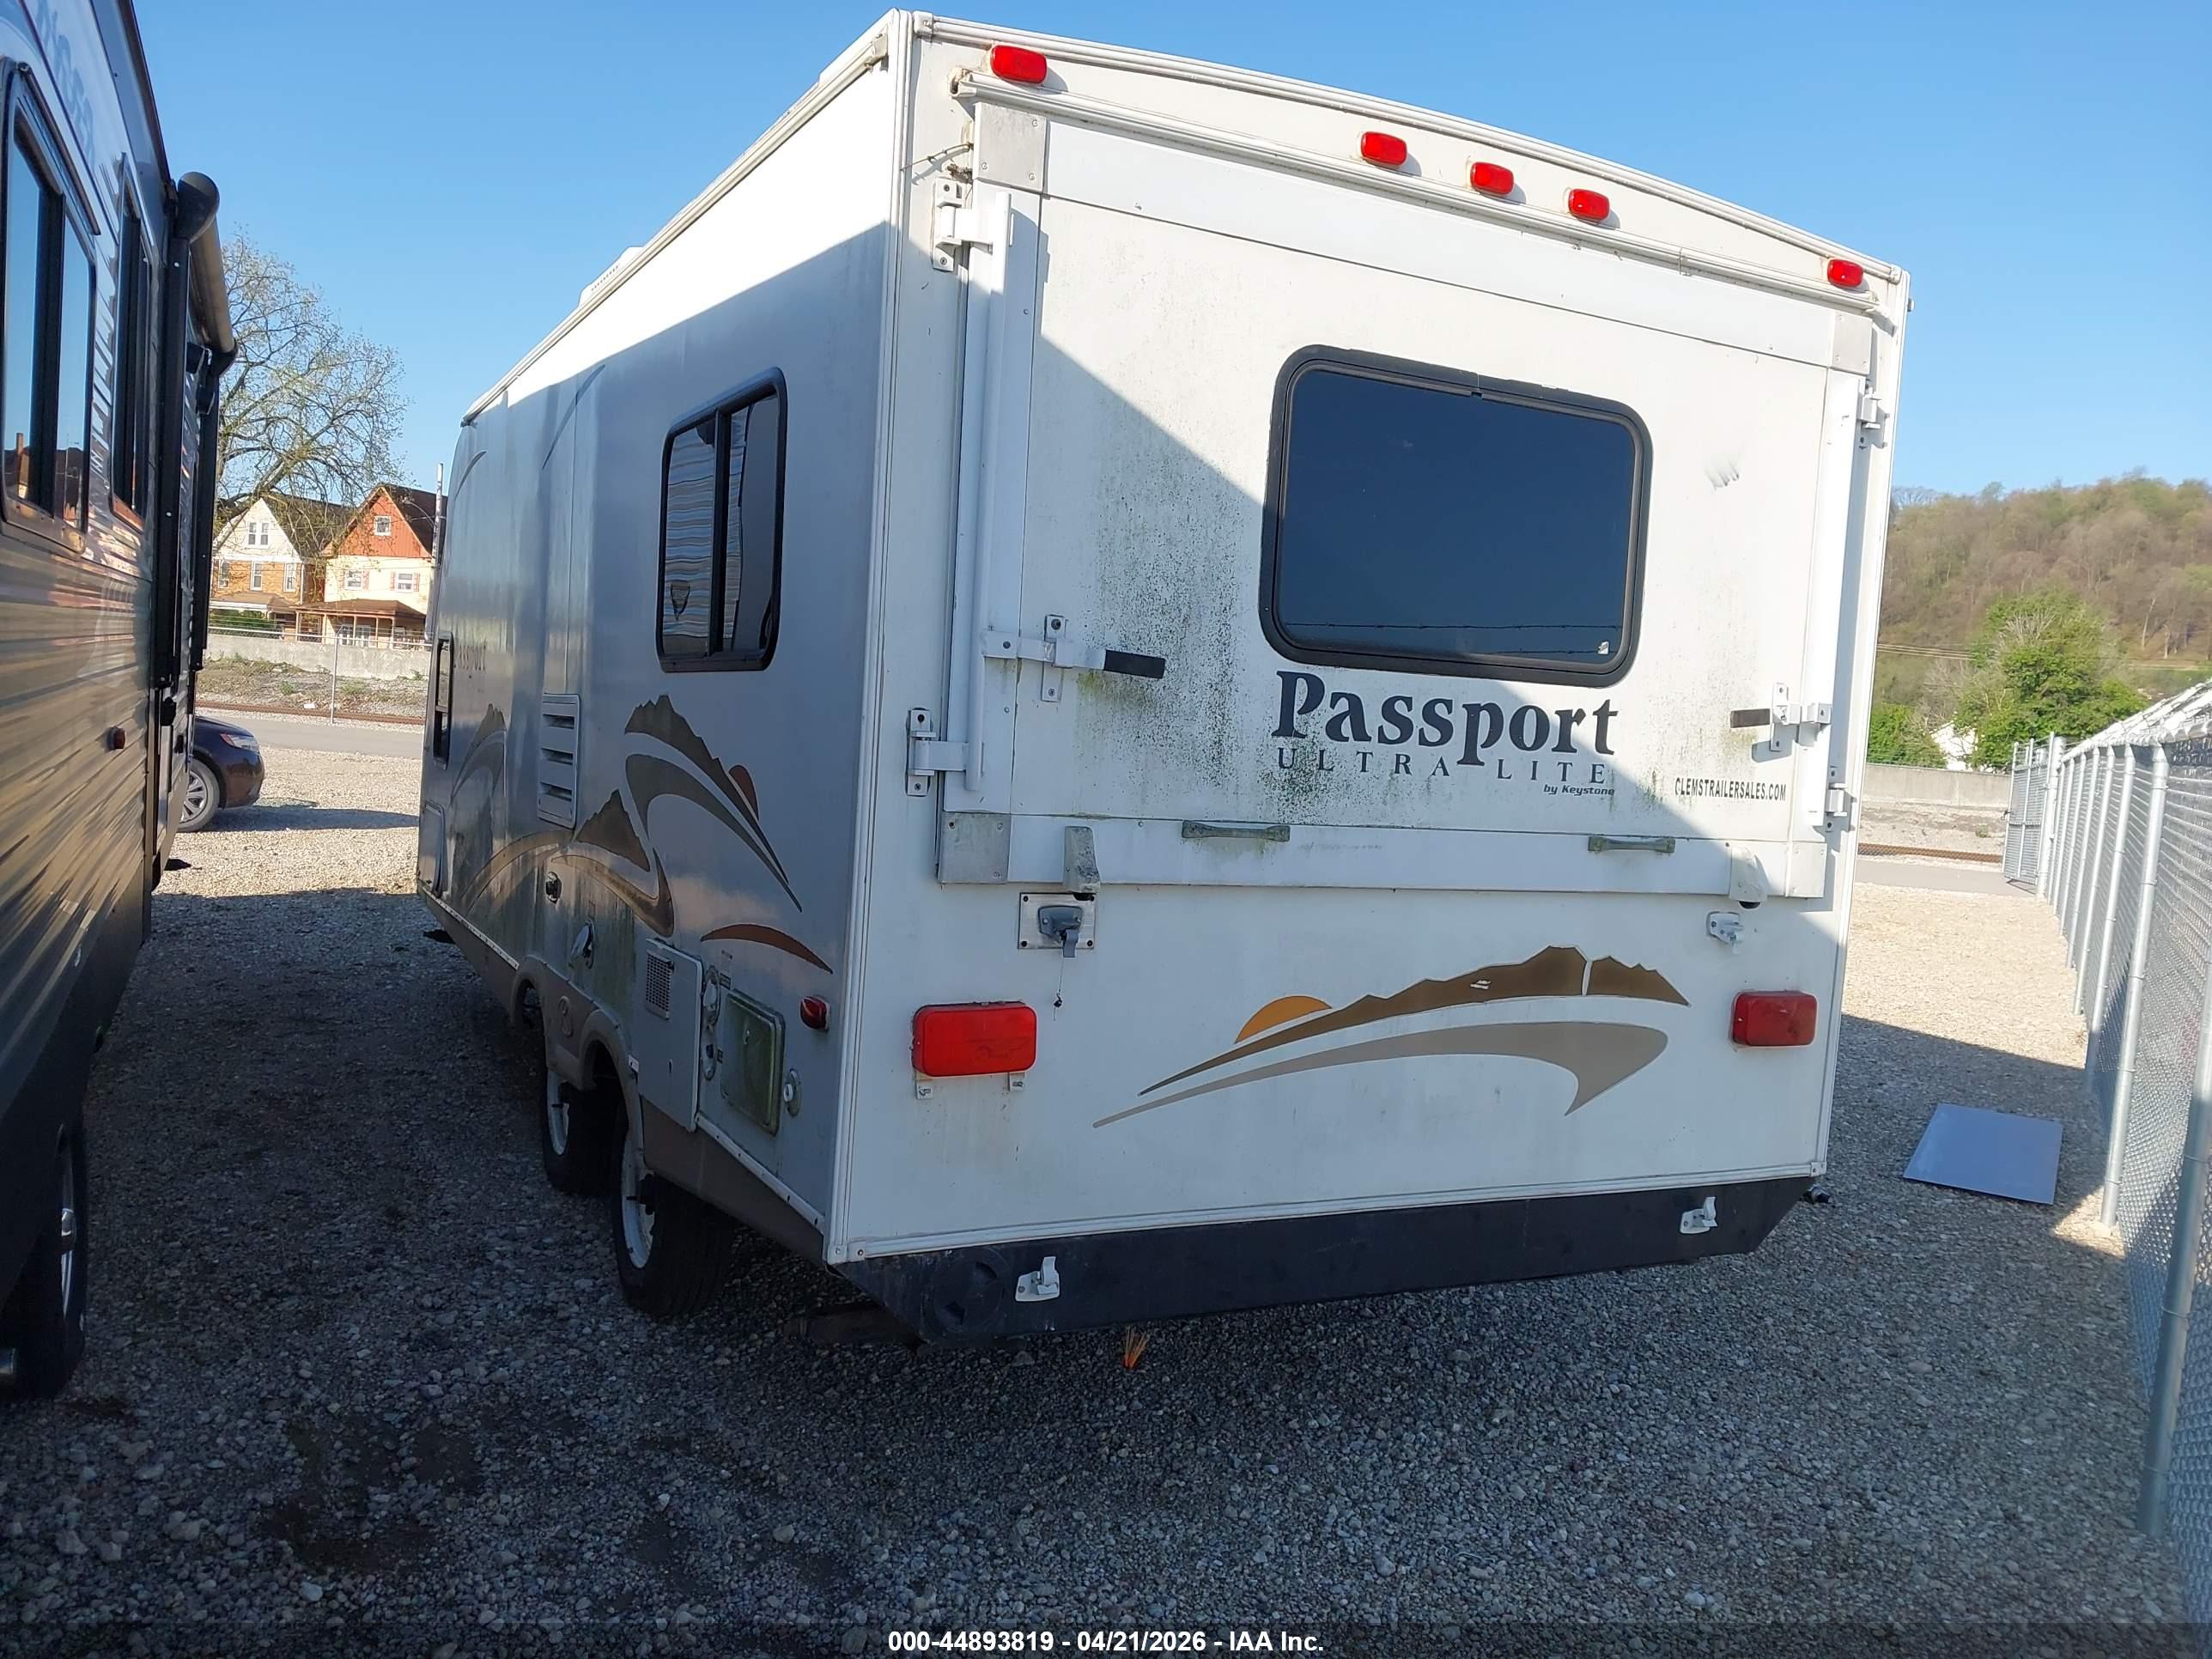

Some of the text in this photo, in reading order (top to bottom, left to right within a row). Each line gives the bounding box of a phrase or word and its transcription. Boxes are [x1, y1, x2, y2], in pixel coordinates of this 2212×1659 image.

[1271, 670, 1619, 767] Passport
[1278, 747, 1606, 784] ULTRA LITE
[1544, 784, 1615, 797] by Keystone
[1674, 777, 1787, 801] CLEMSTRAILERSALES.COM
